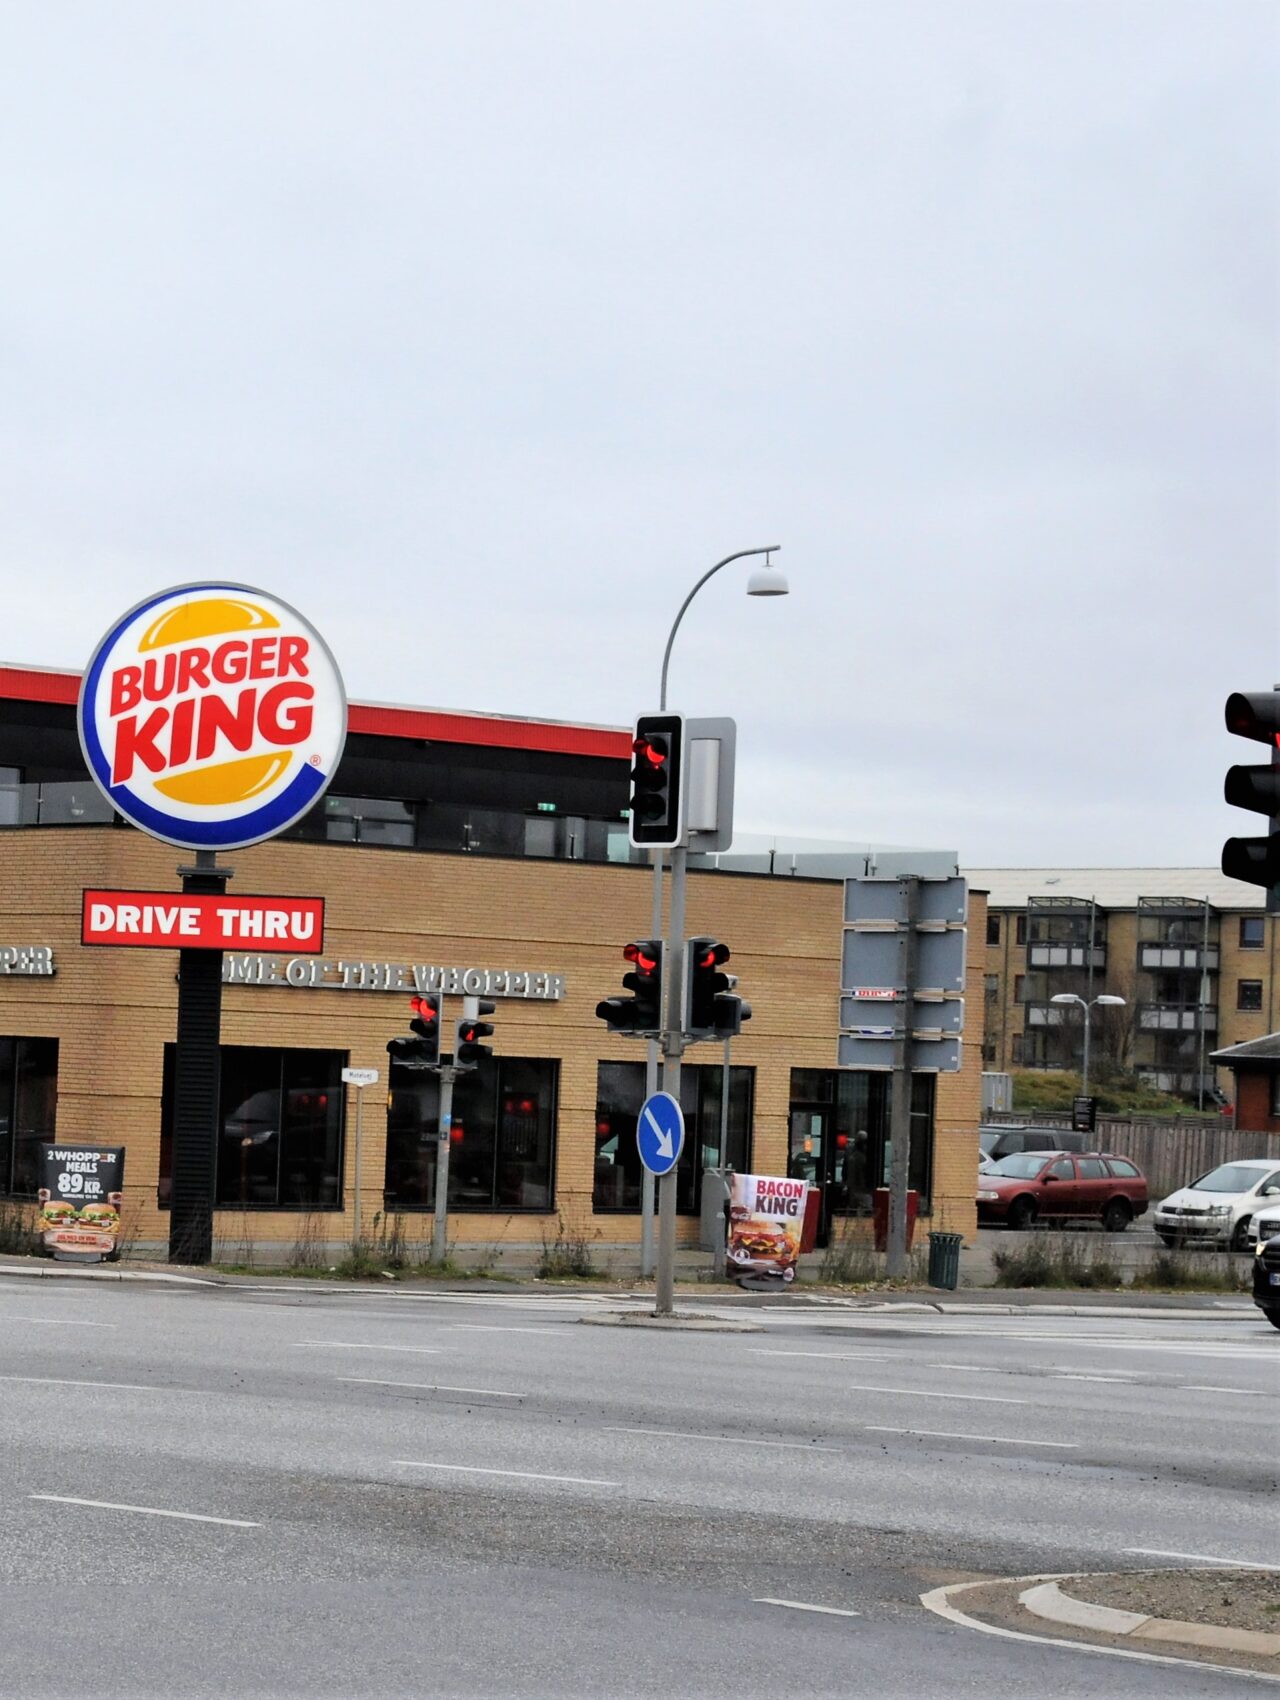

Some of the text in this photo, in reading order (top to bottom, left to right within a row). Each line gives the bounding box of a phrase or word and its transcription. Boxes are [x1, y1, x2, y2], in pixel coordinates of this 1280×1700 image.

[110, 636, 310, 717] BURGER
[112, 681, 315, 785] KING
[89, 903, 315, 940] DRIVE THRU
[286, 957, 333, 988] OF
[337, 960, 409, 991] THE
[412, 964, 566, 1000] WHOPPER
[47, 1150, 117, 1163] 2 WHOPPER
[65, 1161, 98, 1174] MEALS
[57, 1173, 104, 1194] 89 KR.
[757, 1180, 804, 1198] BACON
[755, 1195, 798, 1216] KING
